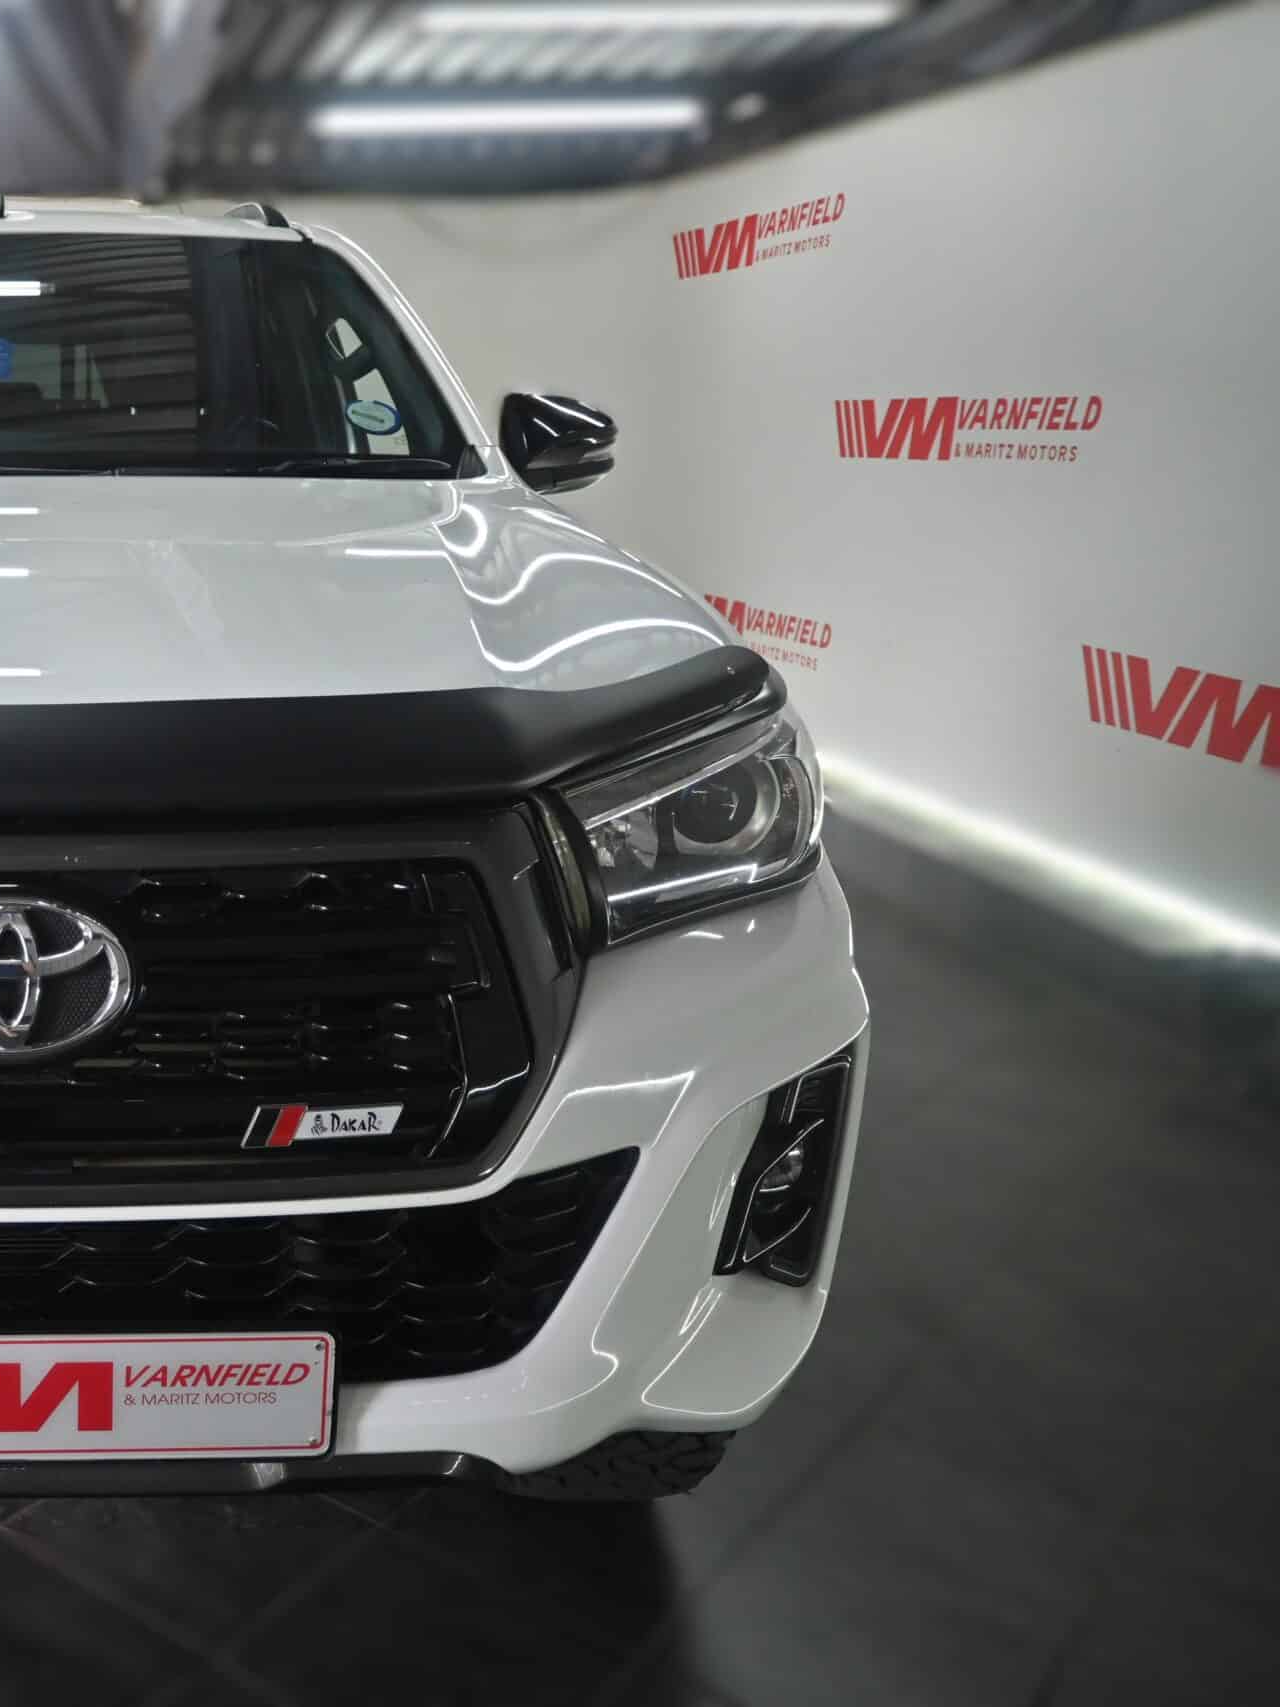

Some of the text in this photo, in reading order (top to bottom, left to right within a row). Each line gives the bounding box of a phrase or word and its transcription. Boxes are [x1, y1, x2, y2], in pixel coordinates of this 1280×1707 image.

[757, 192, 846, 239] VARNFIELD
[694, 214, 759, 275] VM
[793, 234, 832, 254] MOTORS
[861, 396, 960, 461] VM
[957, 395, 1103, 431] VARNFIELD
[954, 443, 1078, 463] & MARITZ MOTORS
[745, 605, 833, 649] VARNFIELD
[123, 1362, 312, 1389] VARNFIELD
[123, 1391, 278, 1407] & MARITZ MOTORS
